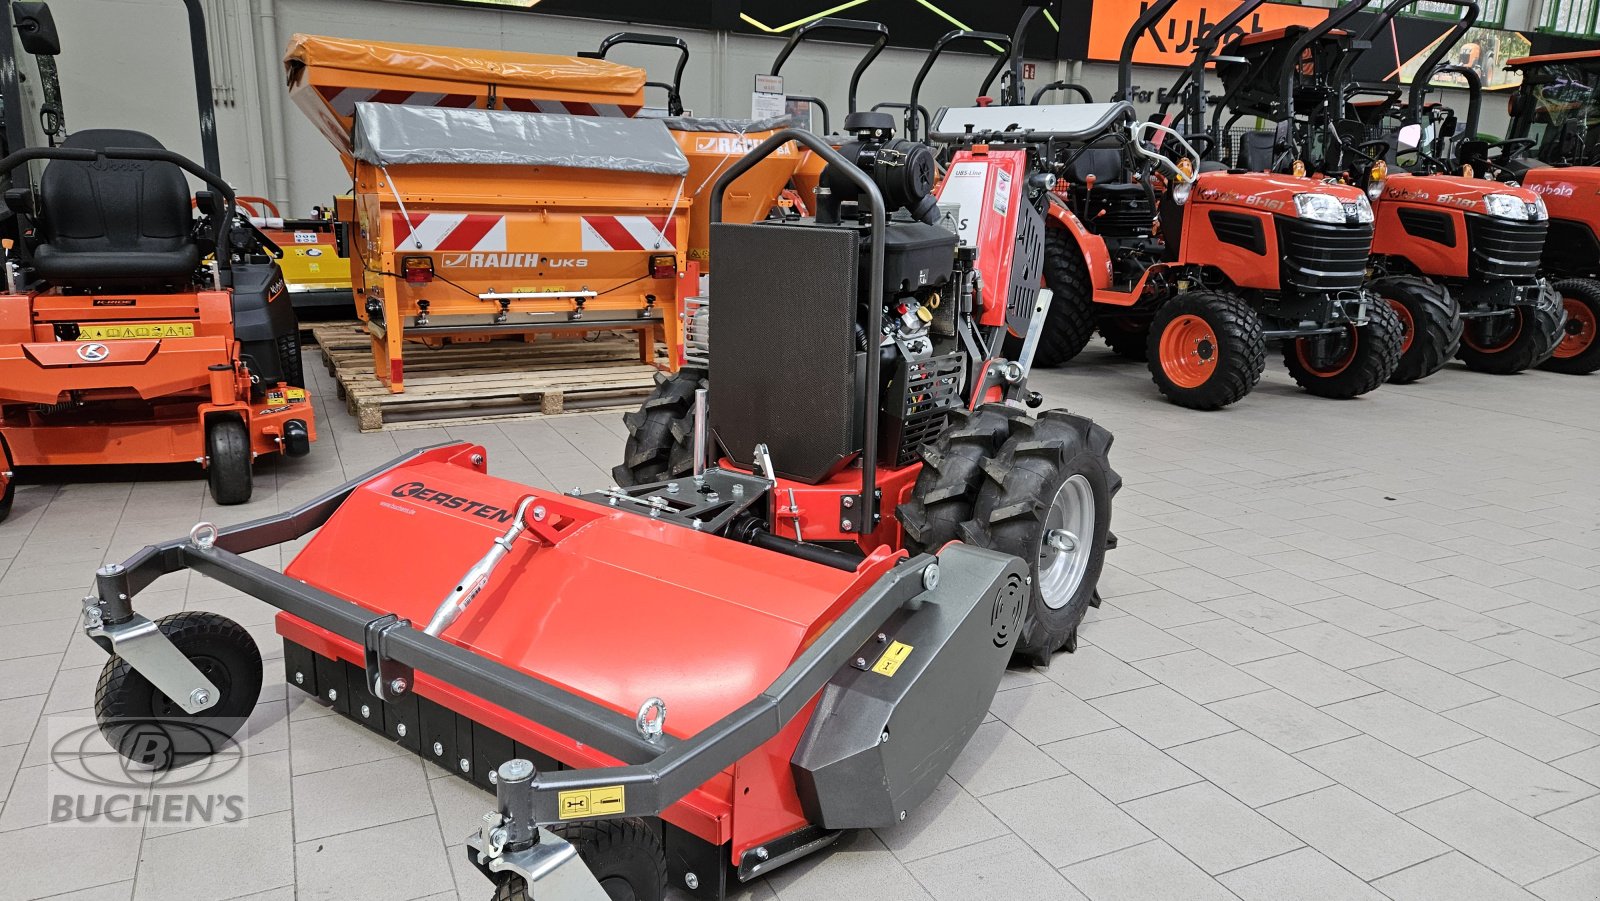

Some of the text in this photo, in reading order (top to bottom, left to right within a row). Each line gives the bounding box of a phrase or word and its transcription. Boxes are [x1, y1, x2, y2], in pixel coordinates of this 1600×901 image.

[1530, 183, 1573, 196] Kubota
[469, 253, 588, 268] RAUCH UKS
[391, 481, 513, 523] KERSTEN
